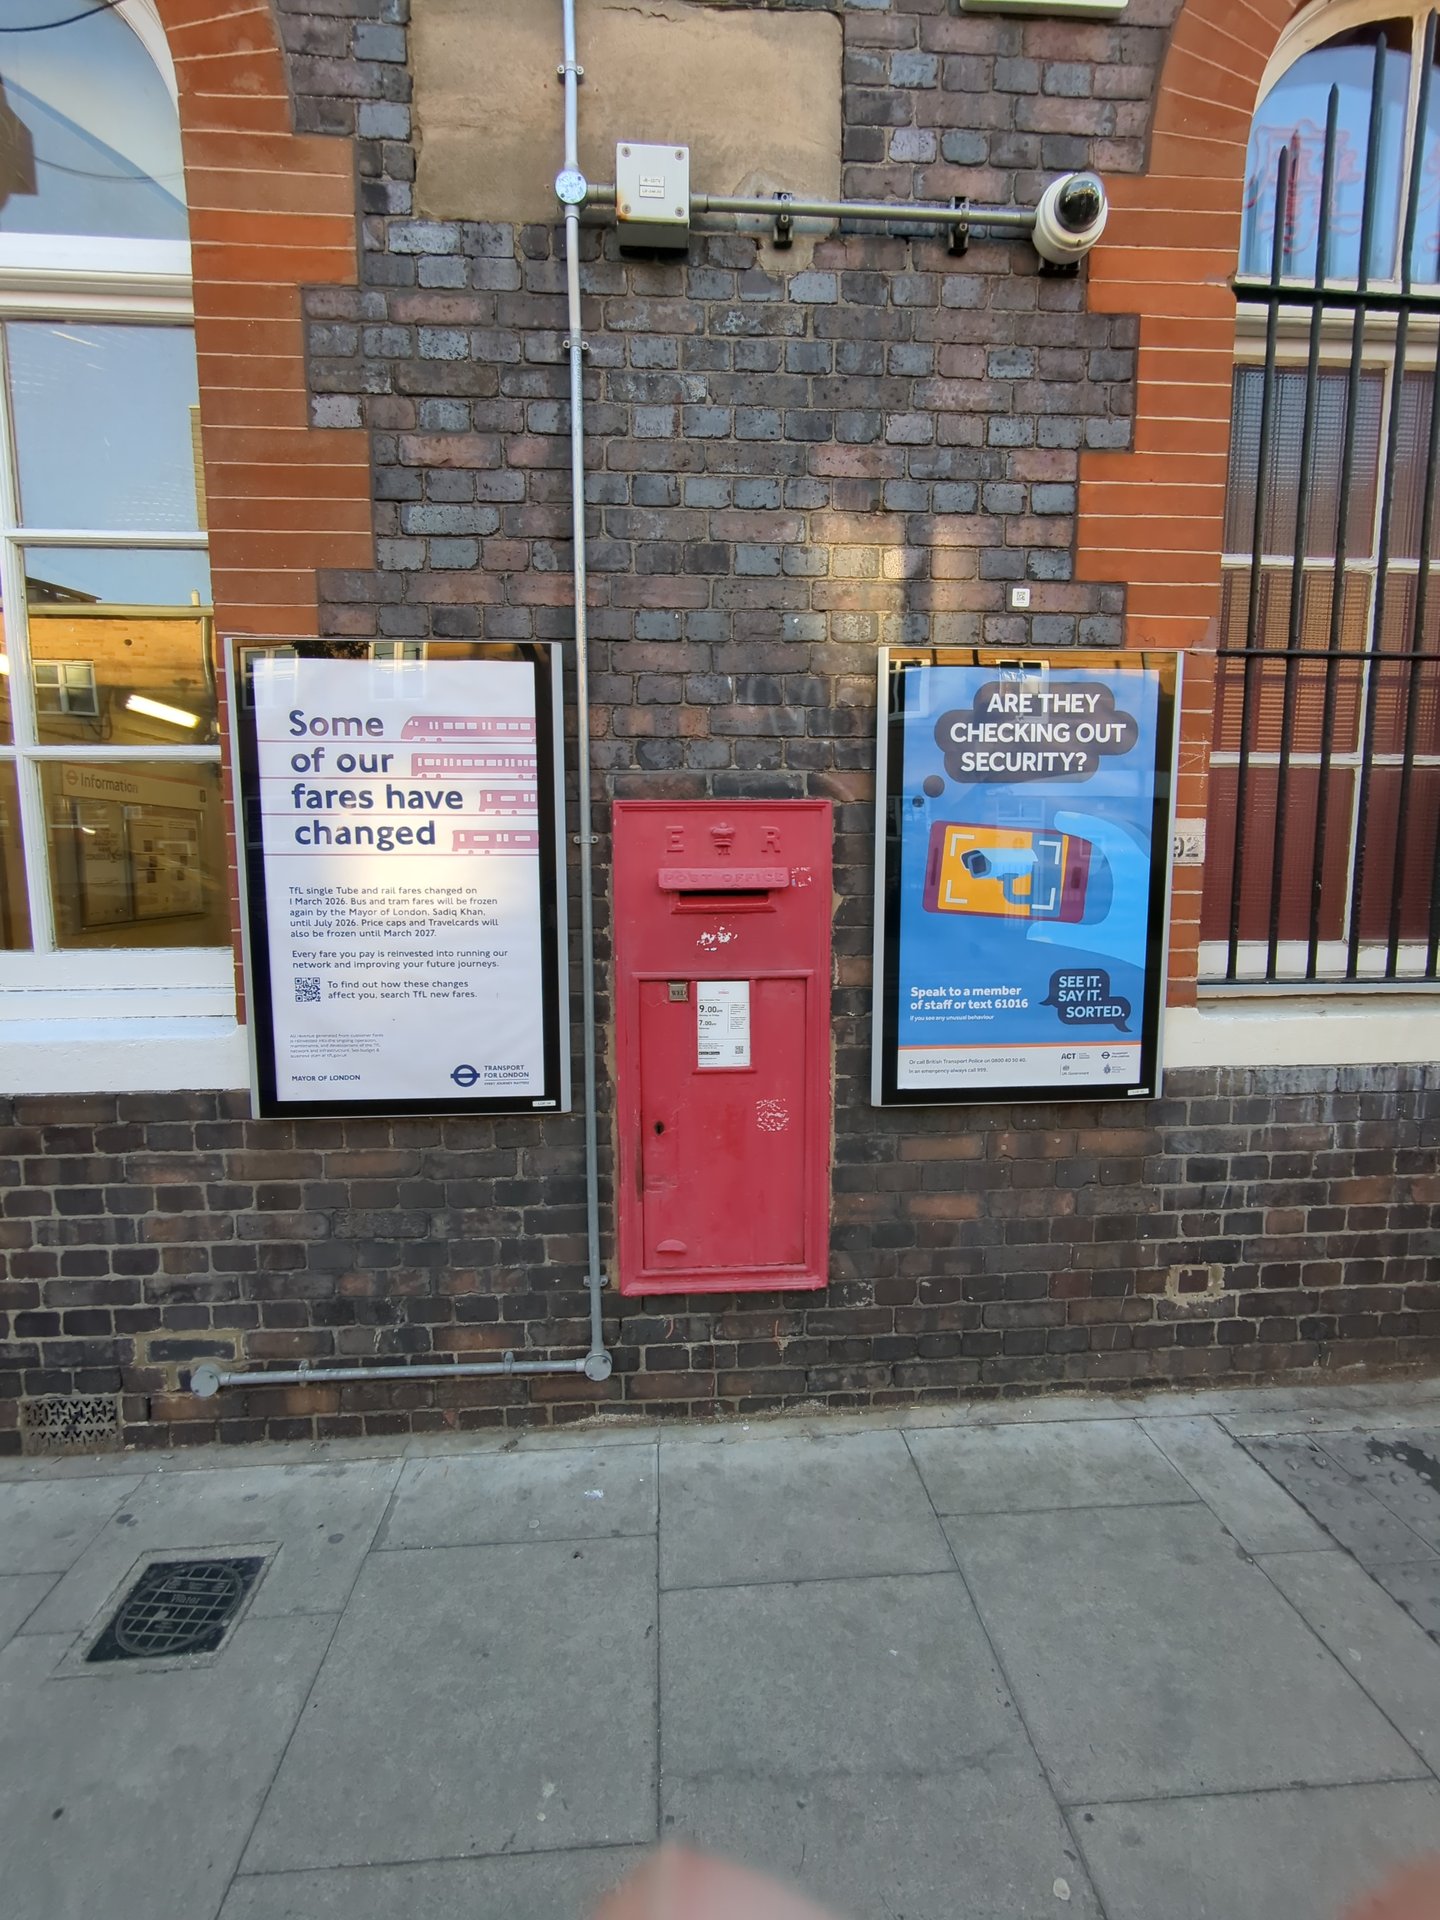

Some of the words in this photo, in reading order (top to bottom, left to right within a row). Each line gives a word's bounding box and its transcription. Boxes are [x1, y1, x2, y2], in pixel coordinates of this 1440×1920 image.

[987, 693, 1033, 713] ARE
[1037, 693, 1101, 713] THEY
[289, 710, 384, 736] Some
[950, 722, 1070, 743] CHECKING
[1075, 723, 1127, 743] OUT
[291, 747, 324, 773] of
[337, 754, 393, 773] our
[961, 752, 1087, 771] SECURITY?
[80, 772, 139, 794] Information
[292, 783, 373, 809] fares
[386, 784, 462, 809] have
[295, 820, 435, 851] changed
[665, 825, 684, 853] E
[761, 825, 781, 853] R
[306, 887, 333, 896] single
[336, 886, 359, 894] Tube
[424, 887, 463, 896] changed
[325, 897, 348, 905] 2026.
[351, 897, 367, 905] Bus
[437, 897, 454, 905] will
[469, 897, 497, 905] frozen
[290, 909, 313, 918] again
[316, 908, 327, 918] by
[349, 908, 377, 917] Mayor
[380, 908, 390, 916] of
[393, 908, 430, 916] London,
[433, 908, 457, 918] Sadiq
[460, 908, 485, 916] Khan,
[314, 919, 332, 928] July
[336, 919, 358, 927] 2026.
[361, 919, 383, 927] Price
[386, 920, 406, 928] caps
[428, 918, 479, 926] Travelcards
[291, 930, 310, 938] also
[327, 929, 356, 937] frozen
[415, 929, 436, 937] 2027.
[292, 950, 317, 959] Every
[319, 950, 337, 958] fare
[387, 950, 433, 958] reinvested
[457, 950, 490, 958] running
[354, 961, 400, 970] improving
[427, 960, 455, 968] future
[458, 961, 500, 969] journeys.
[404, 980, 429, 988] these
[432, 980, 468, 989] changes
[1058, 976, 1084, 988] SEE
[1087, 976, 1102, 987] IT.
[328, 991, 356, 999] affect
[412, 990, 428, 998] TfL
[452, 990, 477, 998] fares.
[911, 987, 947, 999] Speak
[949, 987, 961, 996] to
[963, 988, 970, 996] a
[972, 986, 1022, 996] member
[1058, 990, 1085, 1001] SAY
[1087, 990, 1102, 1001] IT.
[911, 1000, 923, 1010] of
[925, 1000, 953, 1010] staff
[968, 999, 992, 1009] text
[995, 999, 1028, 1008] 61016
[1066, 1006, 1125, 1017] SORTED.
